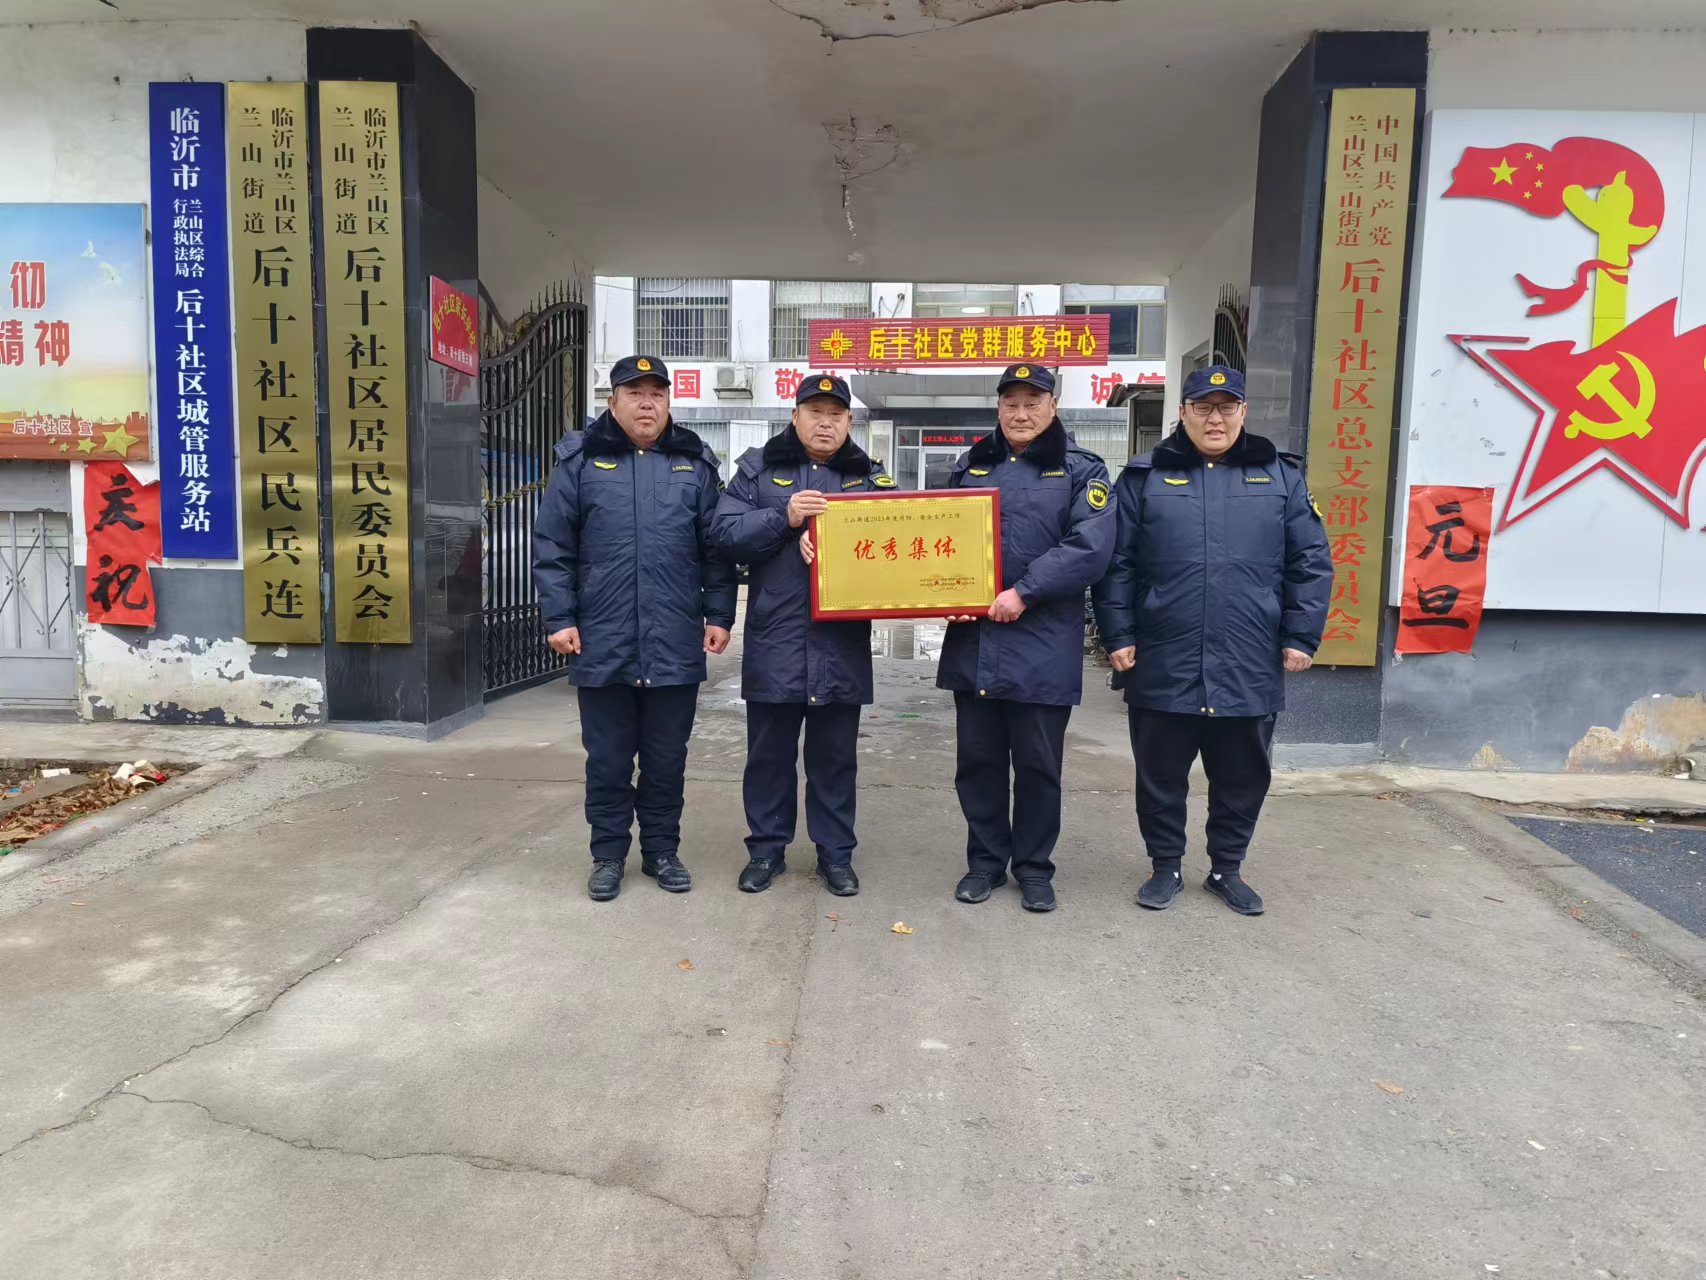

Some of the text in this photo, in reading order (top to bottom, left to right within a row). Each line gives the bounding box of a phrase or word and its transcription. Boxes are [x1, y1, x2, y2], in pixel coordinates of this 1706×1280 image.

[170, 107, 201, 191] 临沂市
[240, 107, 265, 234] 兰山街道
[271, 107, 297, 234] 临沂市兰山区
[332, 106, 357, 235] 兰山街道
[364, 107, 390, 235] 临沂市兰山区
[1335, 114, 1367, 247] 兰山区兰山街道
[1367, 114, 1400, 247] 中国共产党
[9, 260, 46, 310] 彻
[173, 199, 189, 278] 行政执法局
[188, 199, 205, 278] 兰山区综合
[13, 420, 93, 435] 后十社区 宣
[175, 288, 212, 533] 后十社区城管服务站
[251, 246, 304, 620] 后十社区民兵连
[344, 246, 393, 620] 后十社区居民委员会
[674, 370, 700, 399] 国
[853, 535, 957, 561] 优秀集体
[1402, 500, 1479, 630] 元旦
